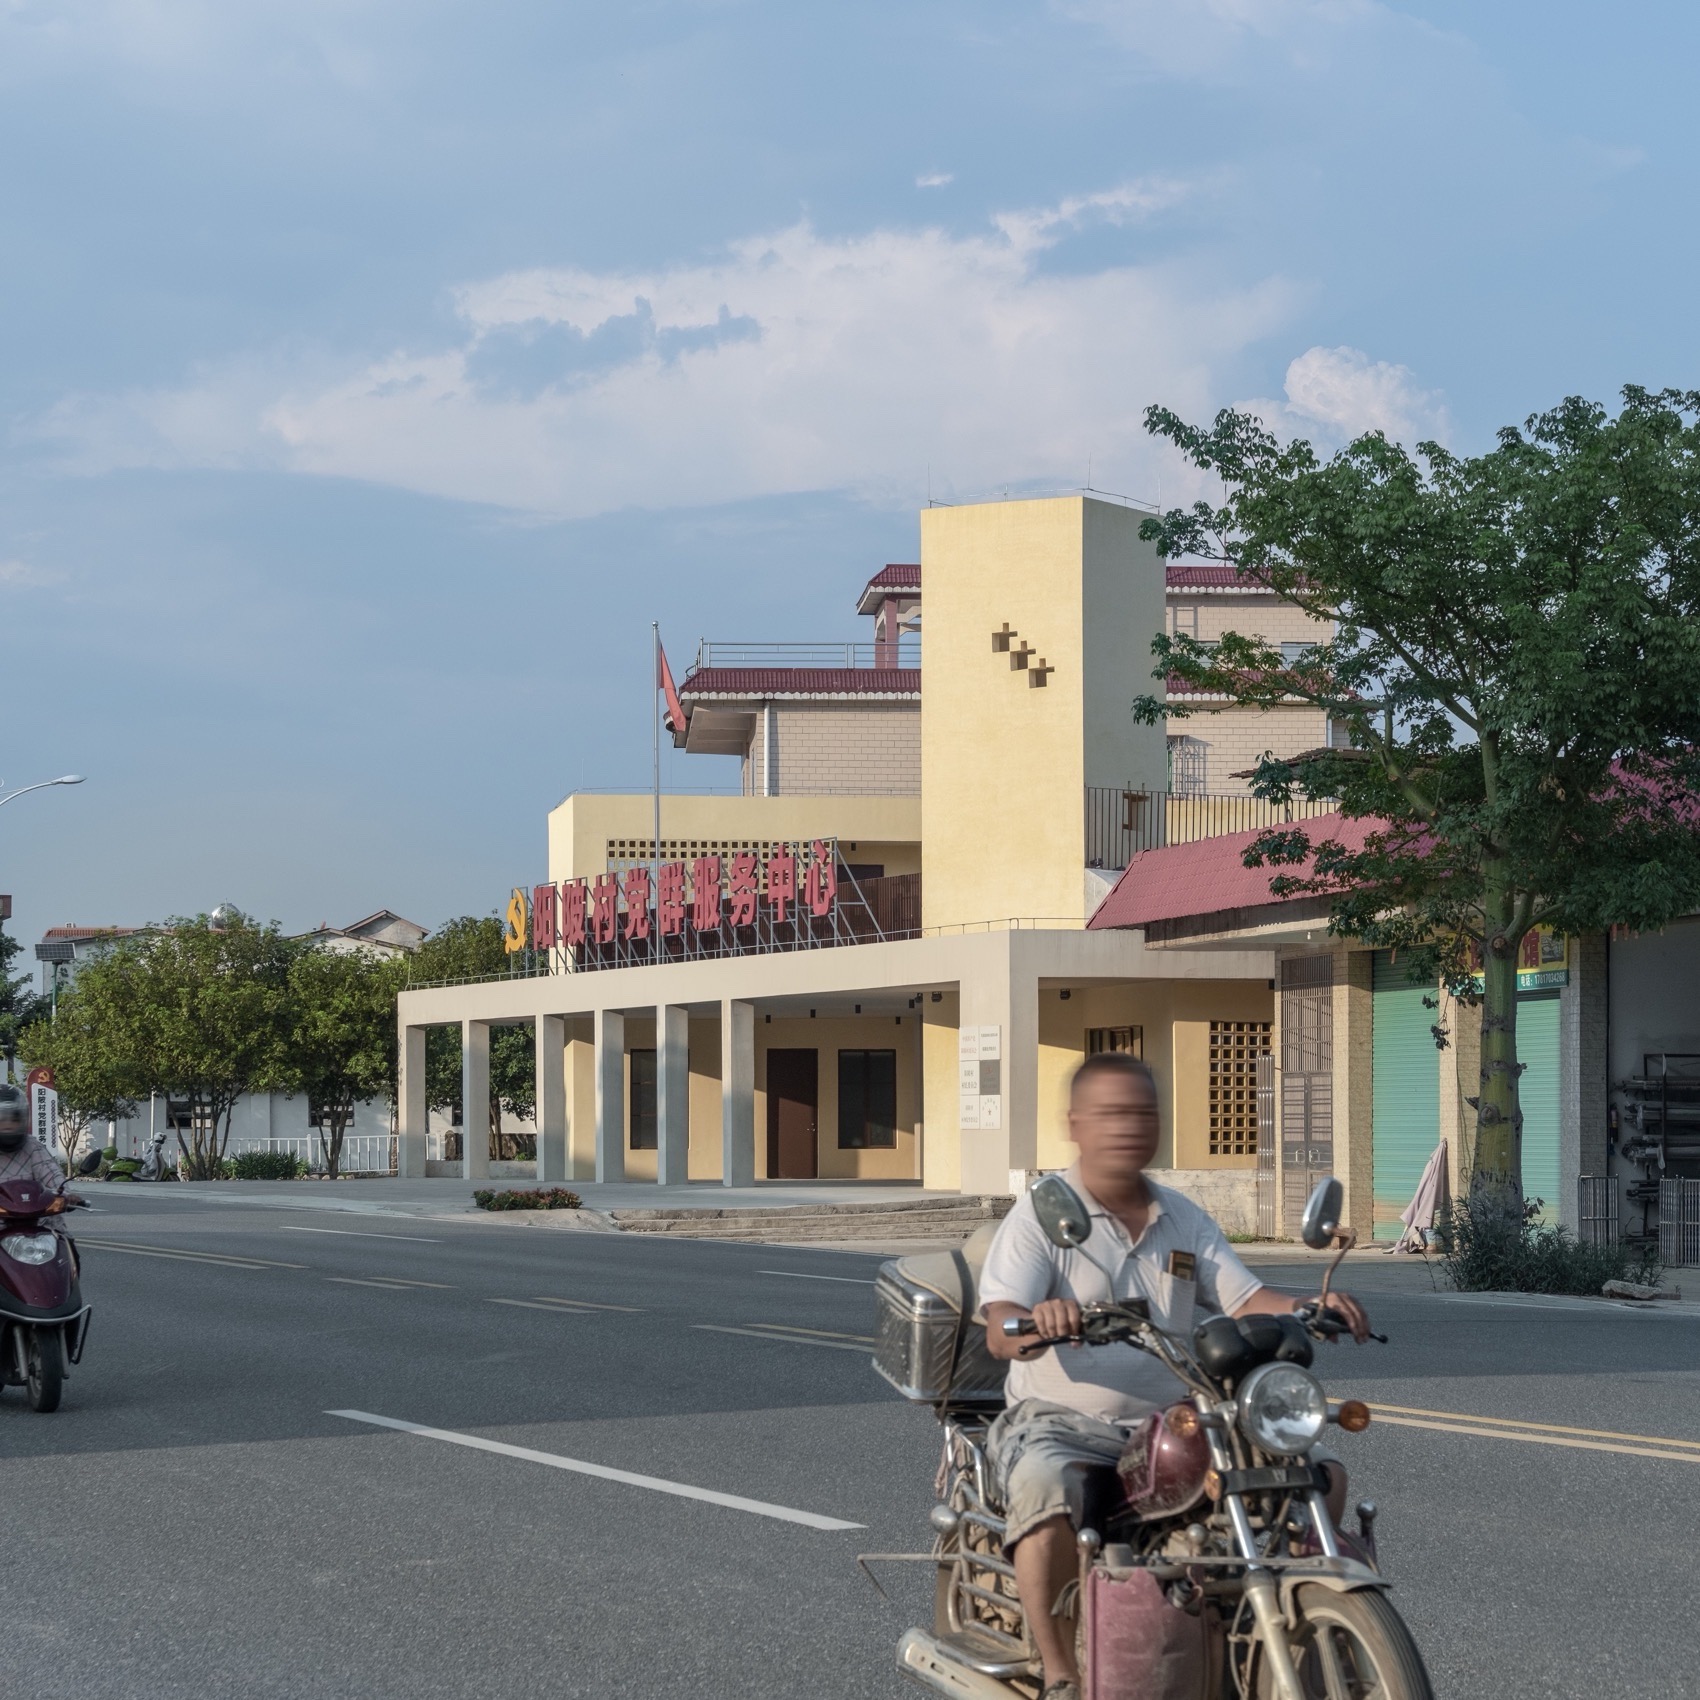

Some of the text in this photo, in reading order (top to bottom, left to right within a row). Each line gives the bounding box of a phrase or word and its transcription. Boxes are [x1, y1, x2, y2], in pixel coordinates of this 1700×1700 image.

[533, 838, 837, 951] 阳陂村党群服务中心
[37, 1088, 47, 1149] 阳陂村党群服务
